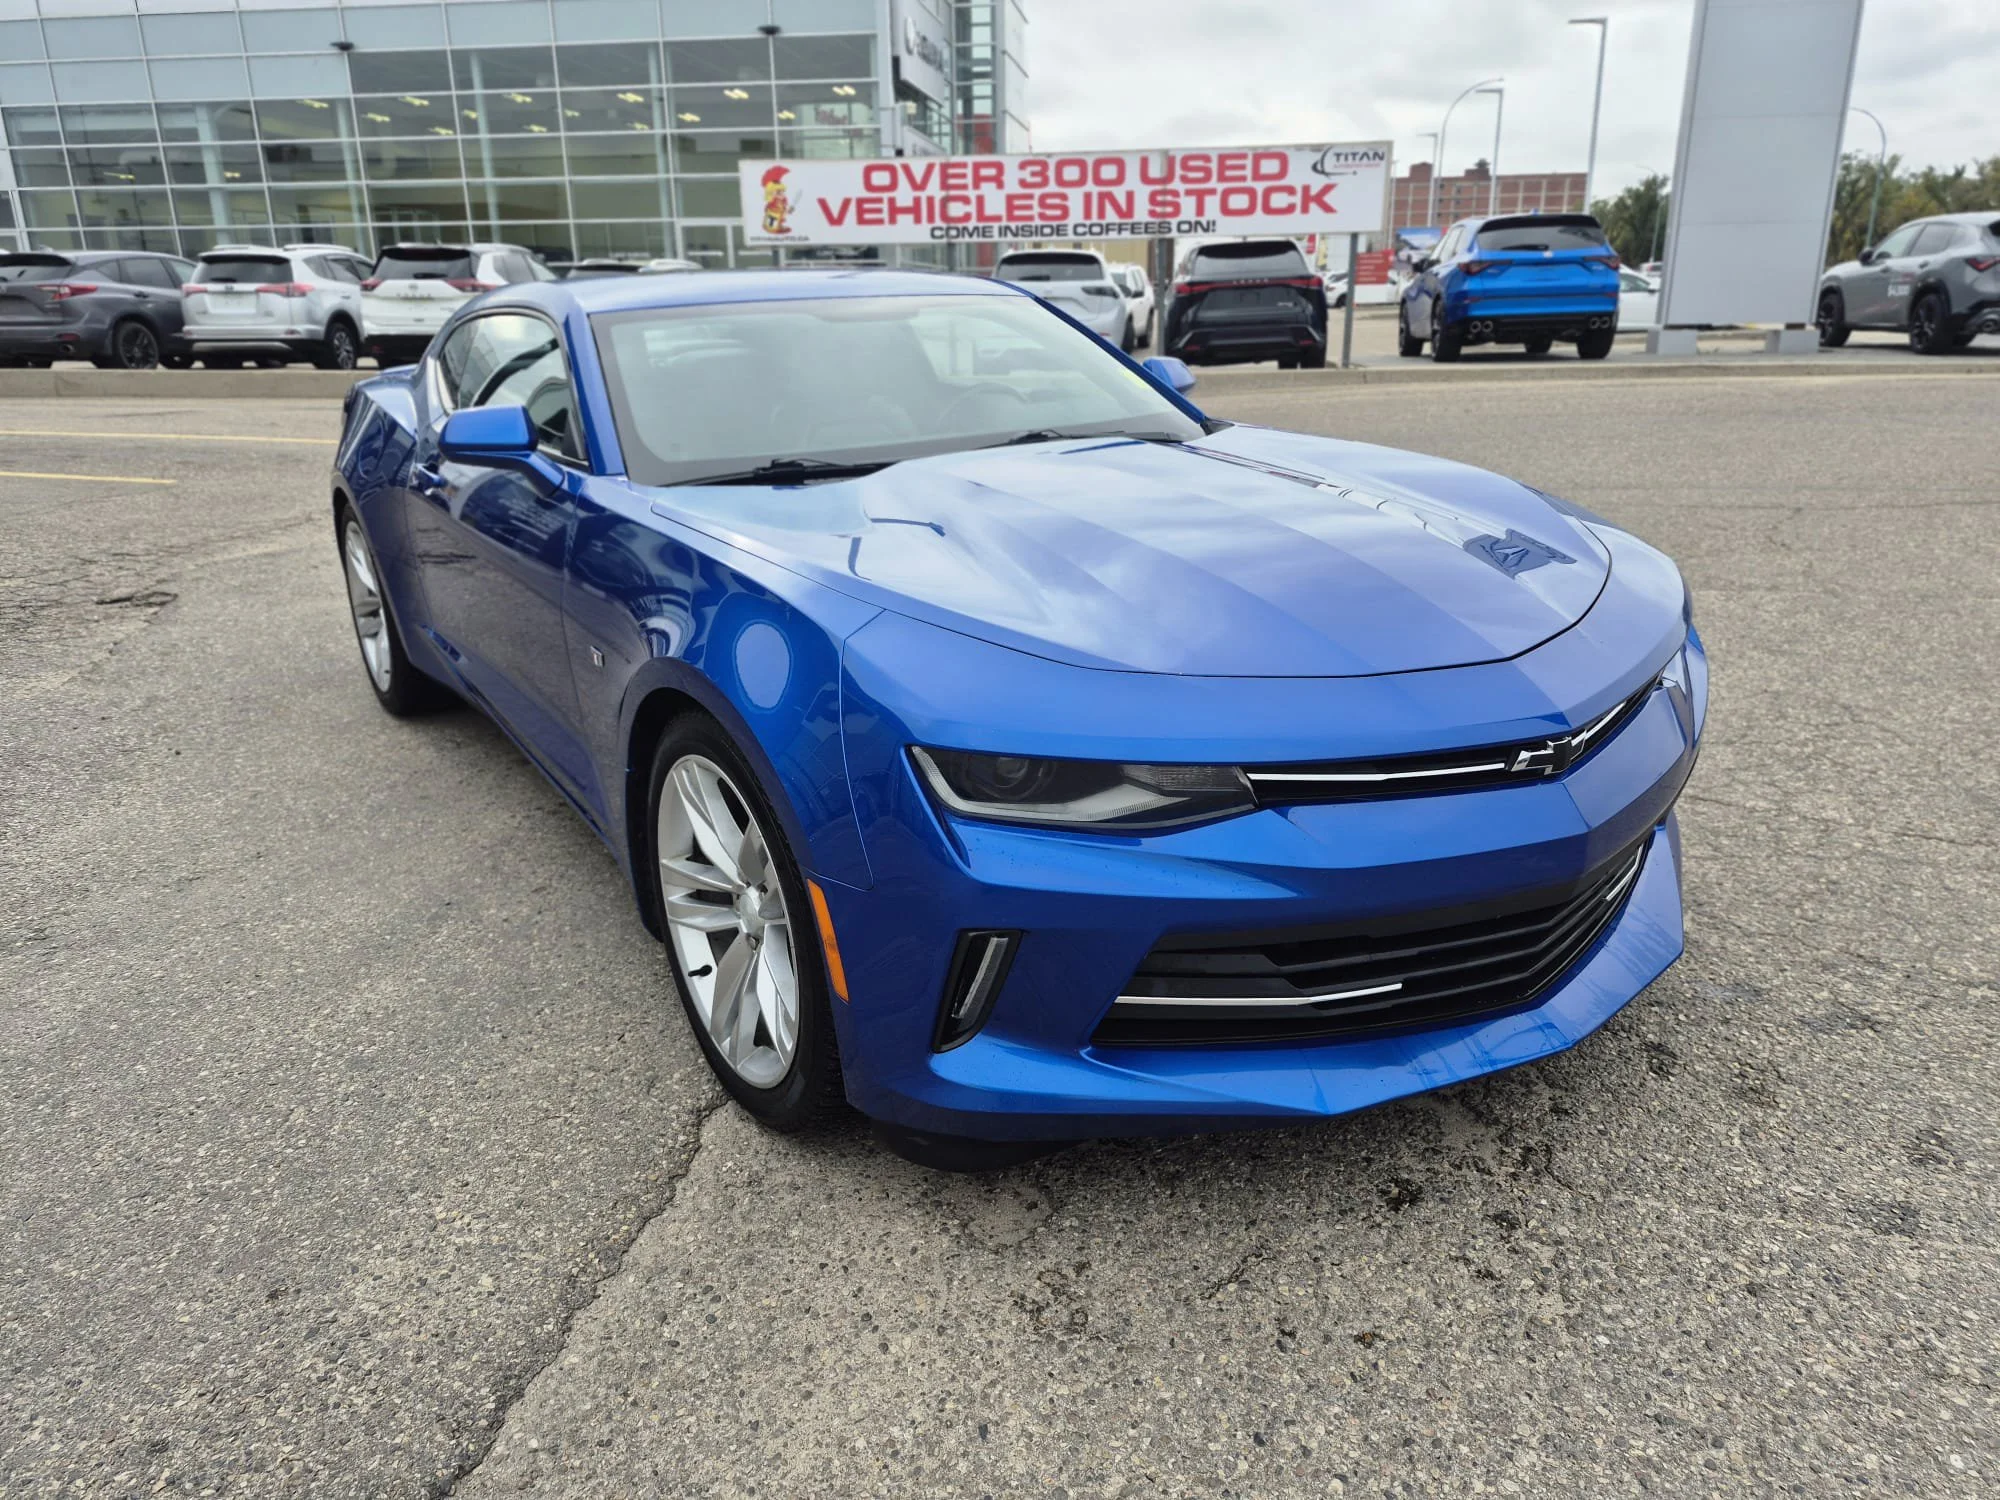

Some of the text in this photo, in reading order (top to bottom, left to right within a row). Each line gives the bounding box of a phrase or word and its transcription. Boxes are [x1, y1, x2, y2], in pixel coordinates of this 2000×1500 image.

[1333, 151, 1385, 162] TITAN
[863, 152, 1289, 194] OVER 300 USED
[818, 183, 1337, 227] VEHICLES IN STOCK
[930, 219, 1217, 239] COME INSIDE COFFEES ON!
